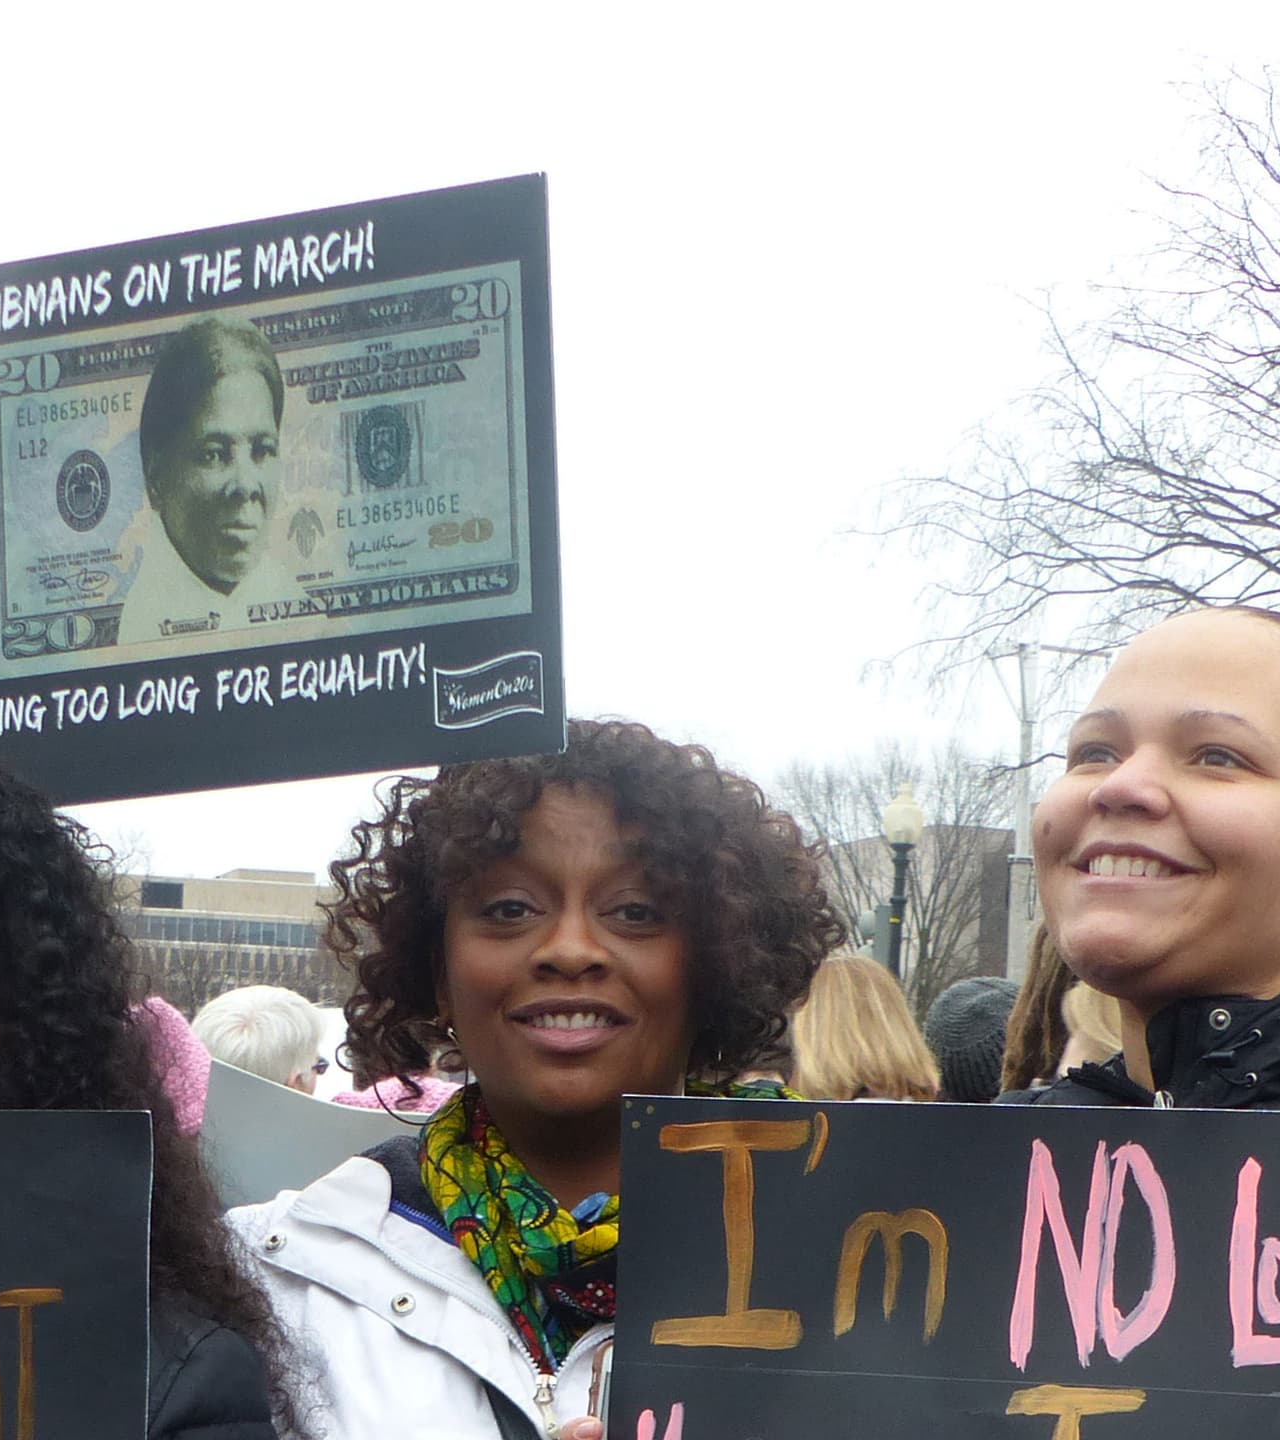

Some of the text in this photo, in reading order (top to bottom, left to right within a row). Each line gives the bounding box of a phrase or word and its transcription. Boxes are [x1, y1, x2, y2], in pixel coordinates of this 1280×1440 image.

[123, 261, 171, 307] ON
[180, 247, 242, 302] THE
[253, 221, 375, 290] MARCH!
[451, 278, 510, 322] 20
[18, 437, 47, 460] L12
[428, 518, 494, 548] 20
[371, 571, 509, 605] DOLLARS
[2, 614, 95, 660] 20
[51, 685, 109, 730] TOO
[119, 677, 200, 719] LONG
[216, 666, 273, 711] FOR
[280, 643, 426, 702] EQUALITY!
[650, 1110, 948, 1351] I'm
